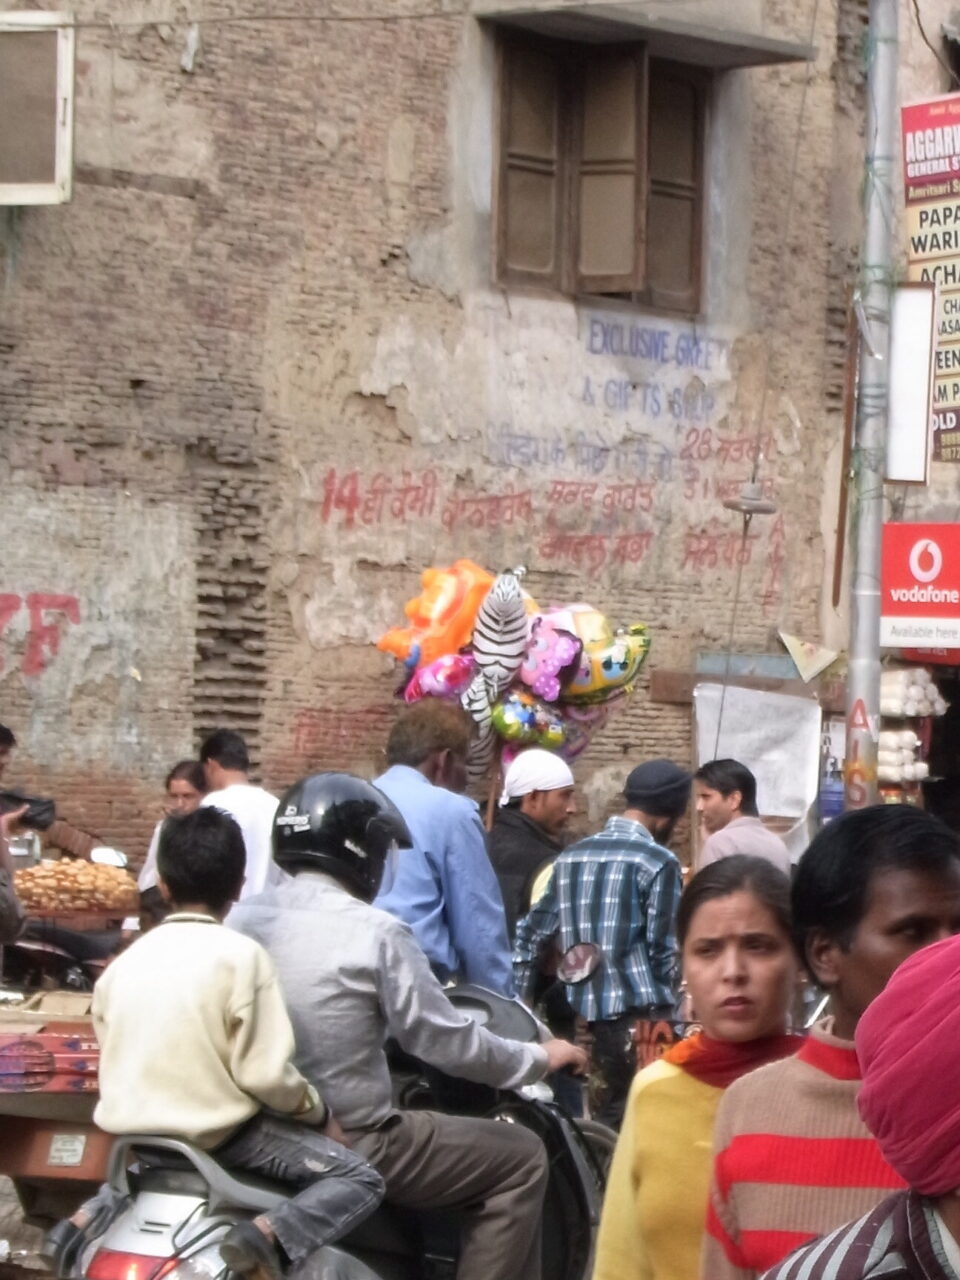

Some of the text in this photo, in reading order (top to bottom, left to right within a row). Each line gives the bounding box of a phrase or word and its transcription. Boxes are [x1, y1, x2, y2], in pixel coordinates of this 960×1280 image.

[907, 157, 951, 178] GENERAL
[587, 319, 671, 363] EXCLUSIVE
[321, 467, 360, 528] 14
[890, 585, 959, 603] vodafone
[890, 624, 959, 639] Available here
